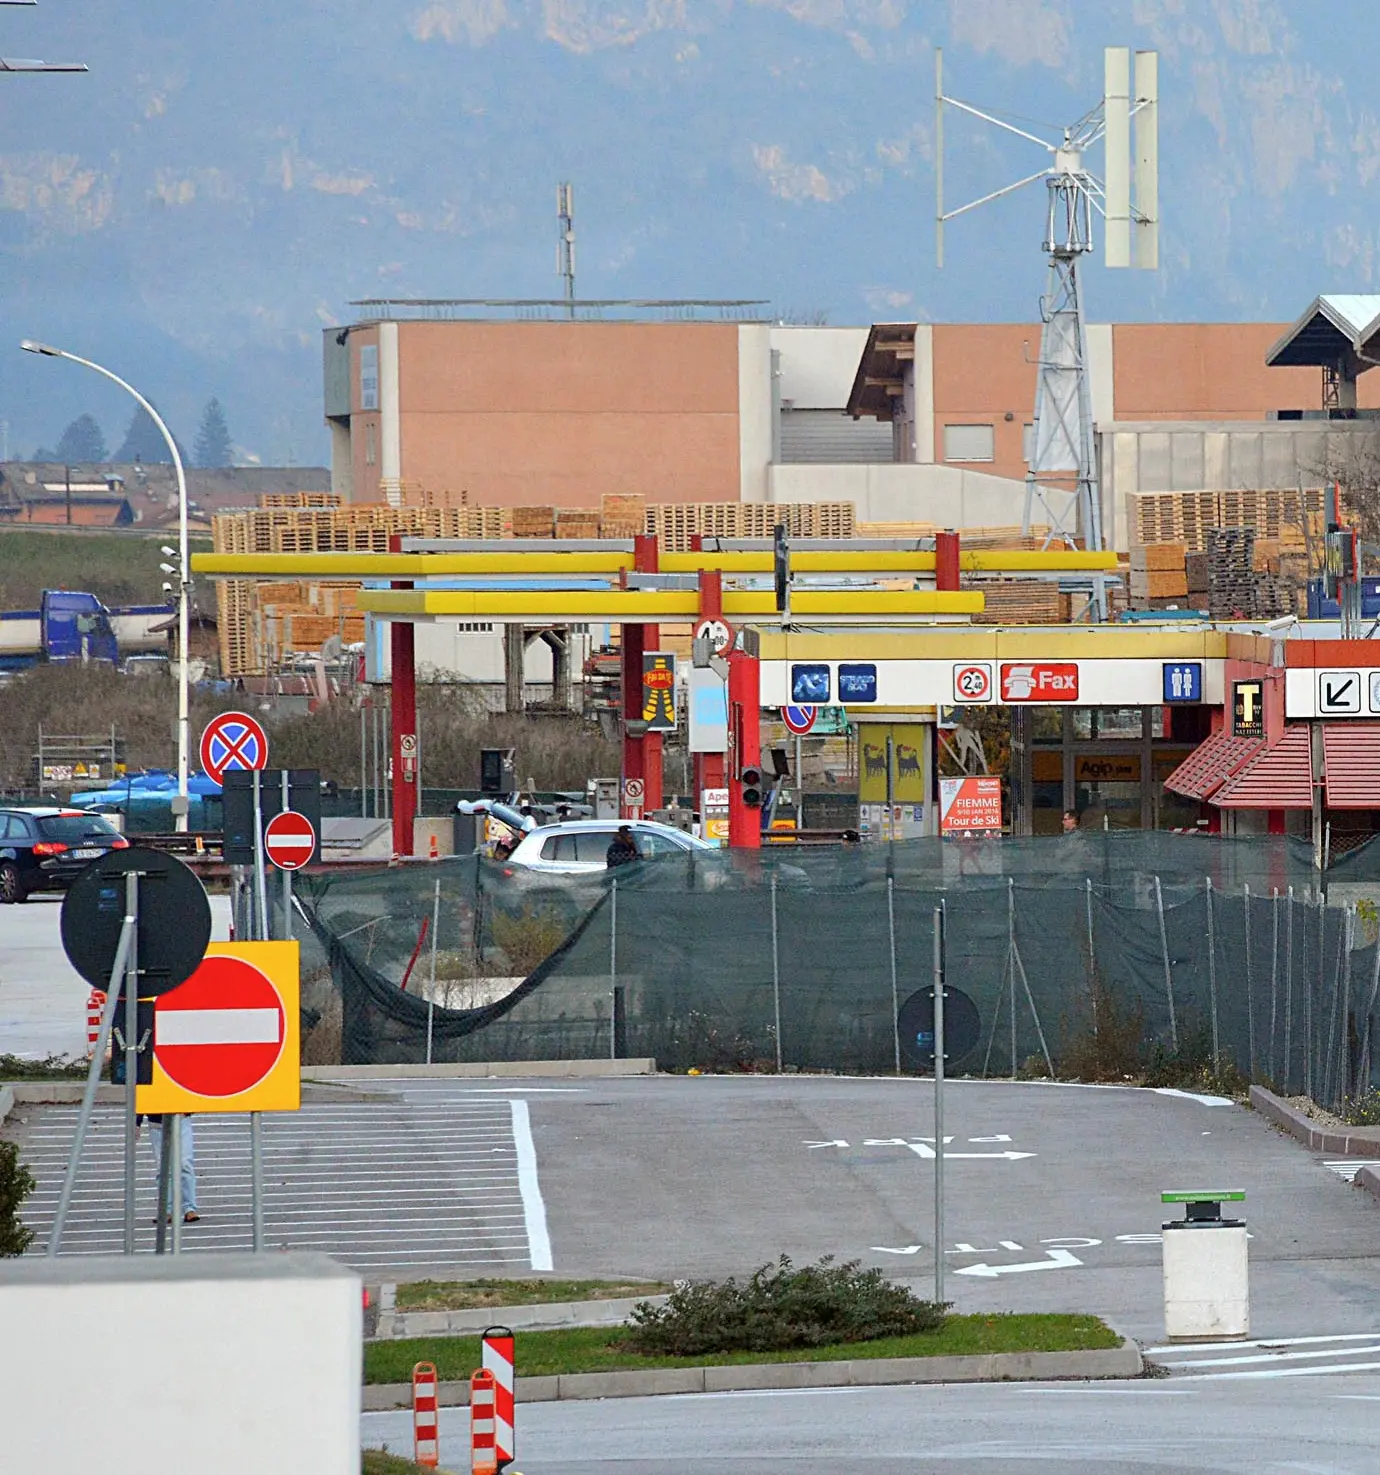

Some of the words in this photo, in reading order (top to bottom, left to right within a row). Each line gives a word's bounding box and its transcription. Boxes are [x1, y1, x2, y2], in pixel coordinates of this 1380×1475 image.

[1039, 671, 1075, 690] Fax
[1237, 684, 1260, 722] T
[1080, 760, 1113, 777] Agip
[956, 798, 999, 808] FIEMME
[948, 816, 970, 826] Tour
[971, 816, 984, 825] de
[985, 815, 999, 825] Ski
[801, 1133, 1013, 1149] PARK
[869, 1231, 1254, 1255] SCITA
